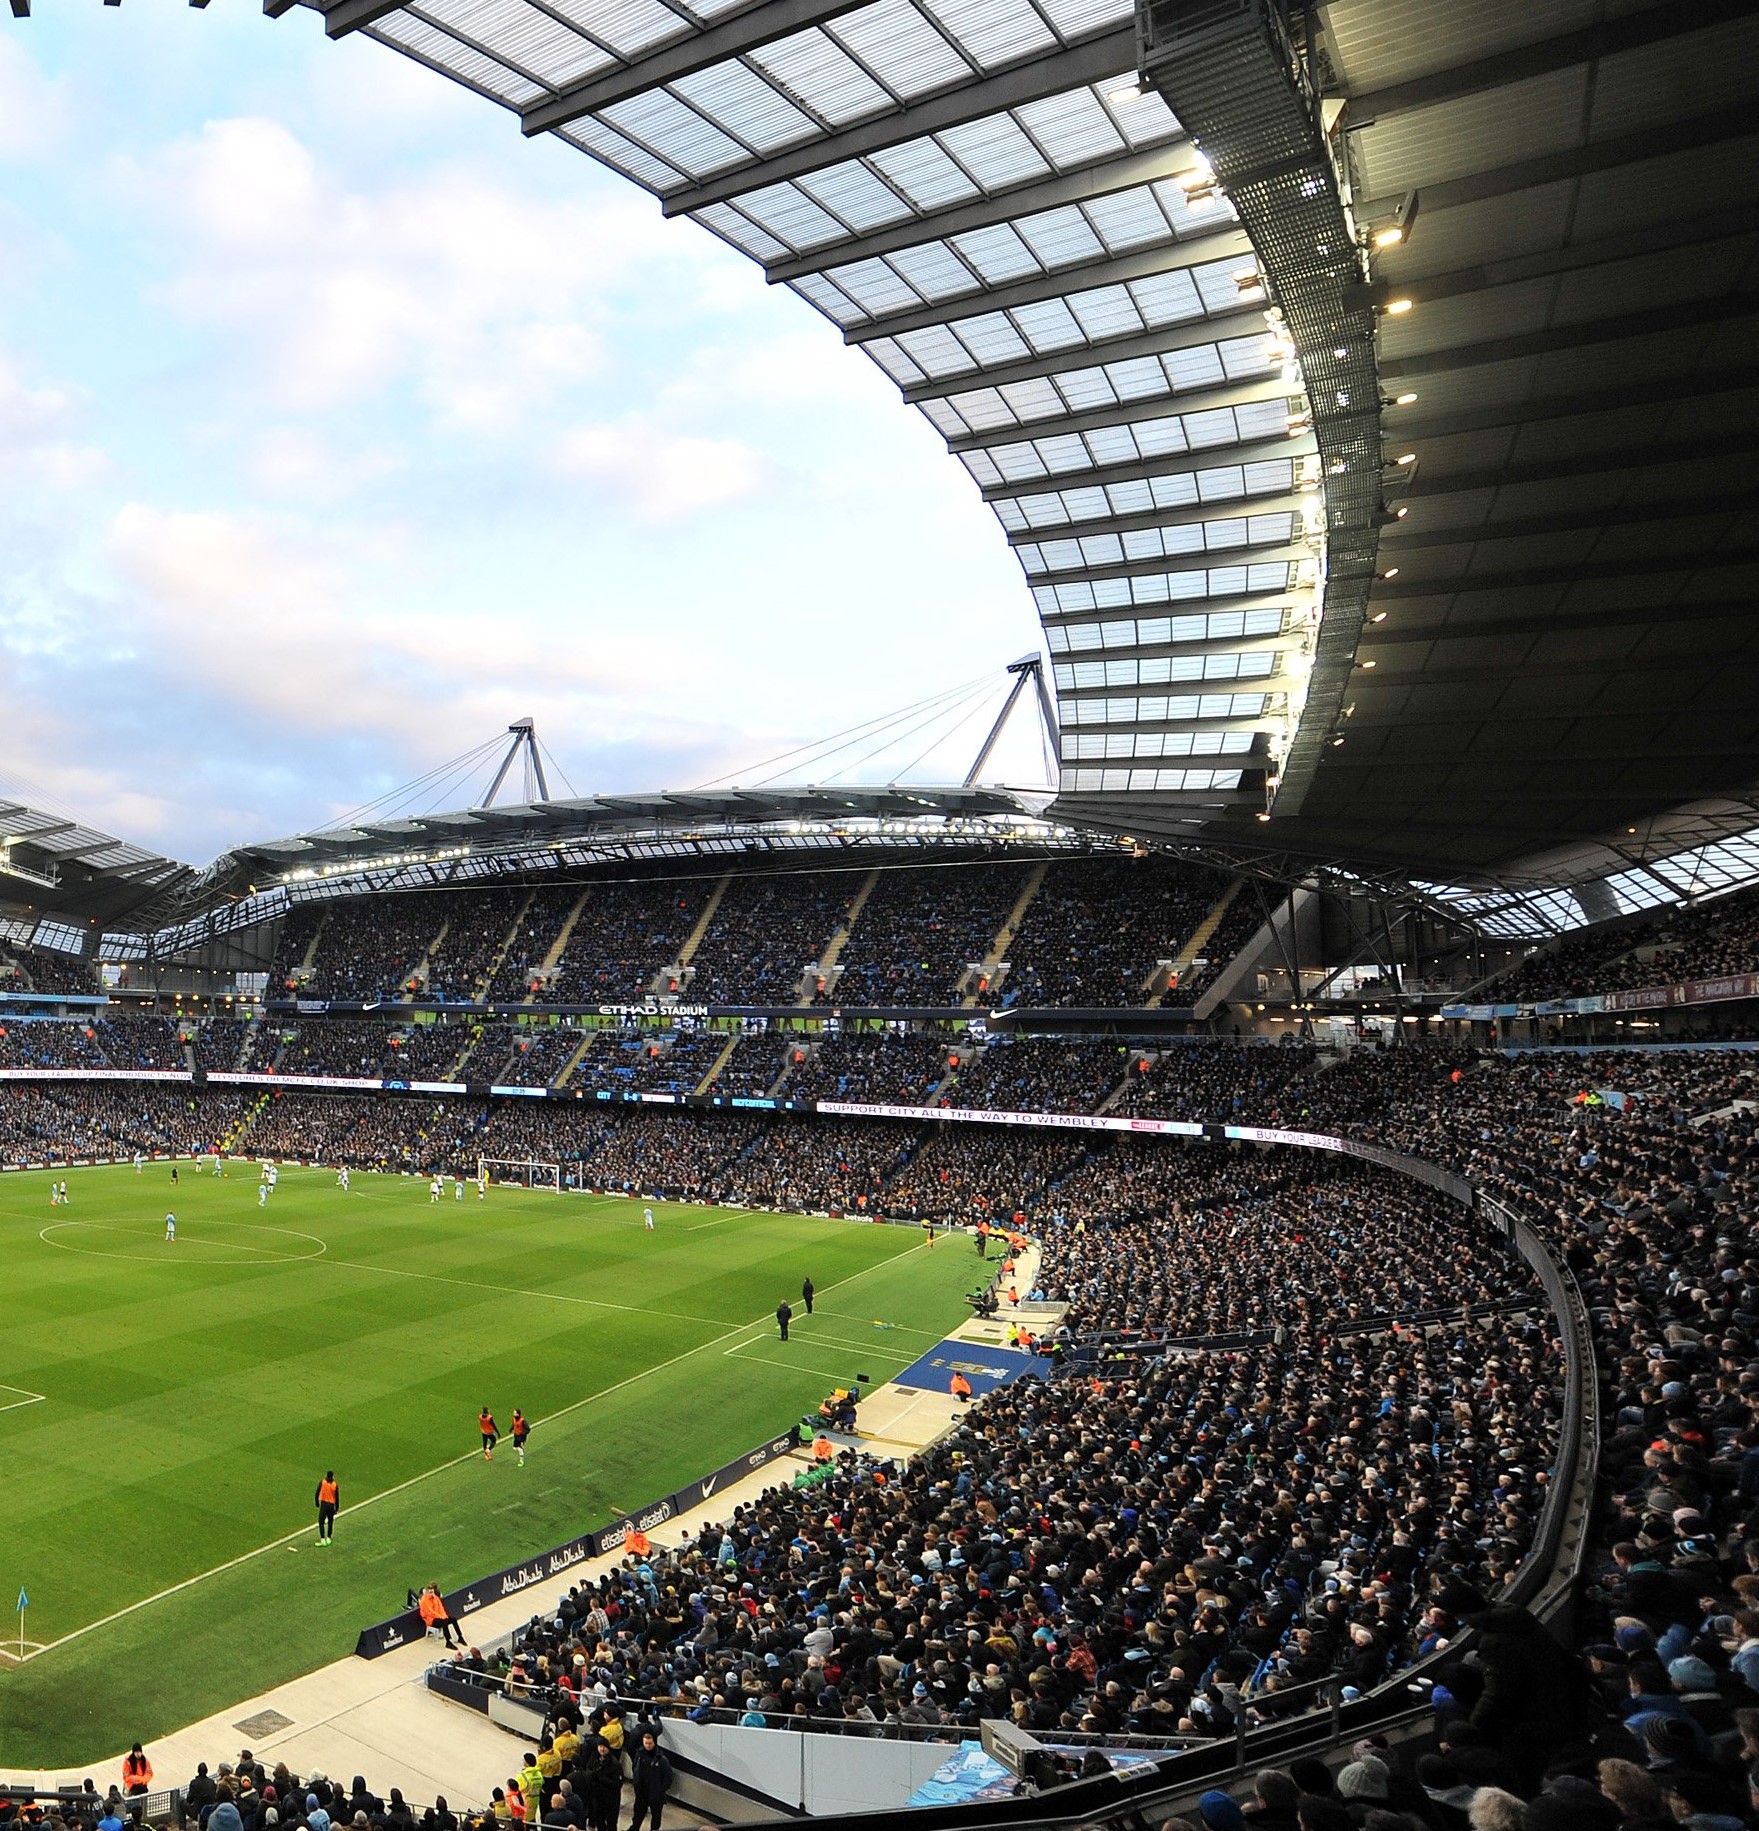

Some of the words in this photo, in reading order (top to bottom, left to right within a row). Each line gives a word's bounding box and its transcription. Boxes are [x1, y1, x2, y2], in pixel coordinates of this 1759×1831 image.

[599, 1005, 658, 1015] ETIHAD
[660, 1006, 708, 1016] STADIUM
[824, 1104, 883, 1113] SUPPORT
[889, 1108, 916, 1116] CITY
[950, 1111, 975, 1119] THE
[1014, 1114, 1032, 1122] TO
[1038, 1116, 1108, 1127] WEMBLEY
[1256, 1131, 1279, 1140] BUY
[843, 1212, 874, 1223] betsafe
[640, 1506, 664, 1532] etisalat
